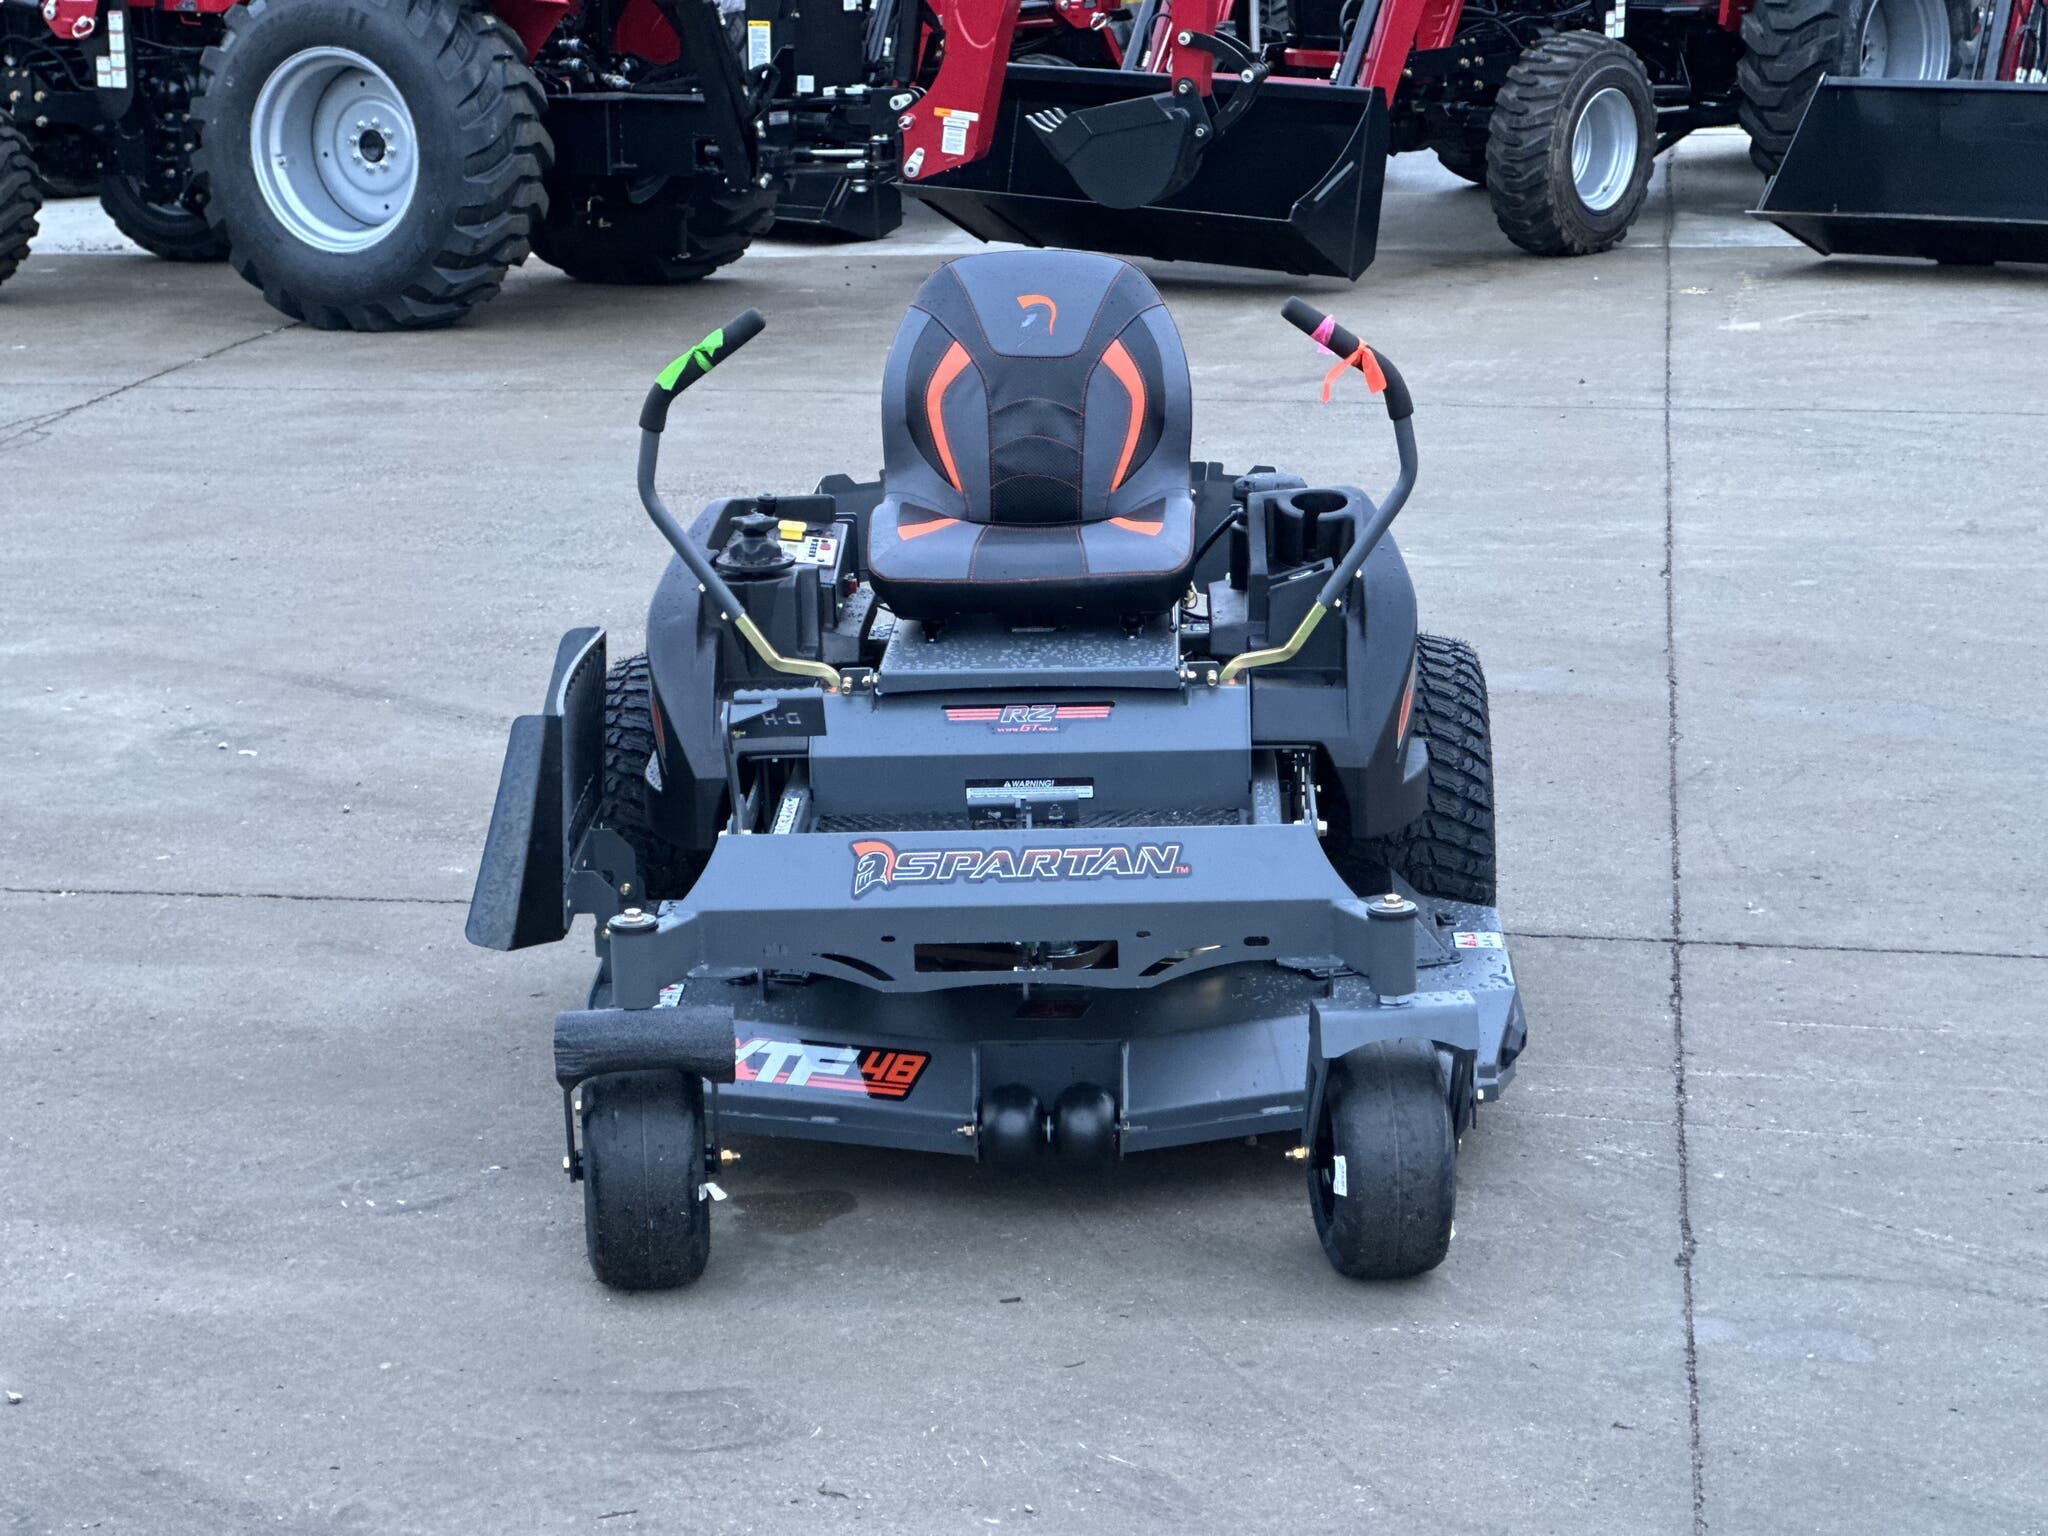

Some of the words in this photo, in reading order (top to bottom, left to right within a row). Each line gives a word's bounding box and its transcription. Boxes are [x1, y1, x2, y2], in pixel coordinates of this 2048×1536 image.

[1000, 704, 1057, 723] RZ
[1011, 779, 1055, 788] WARNING!
[892, 846, 1180, 880] SPARTAN
[861, 1050, 927, 1084] 48
